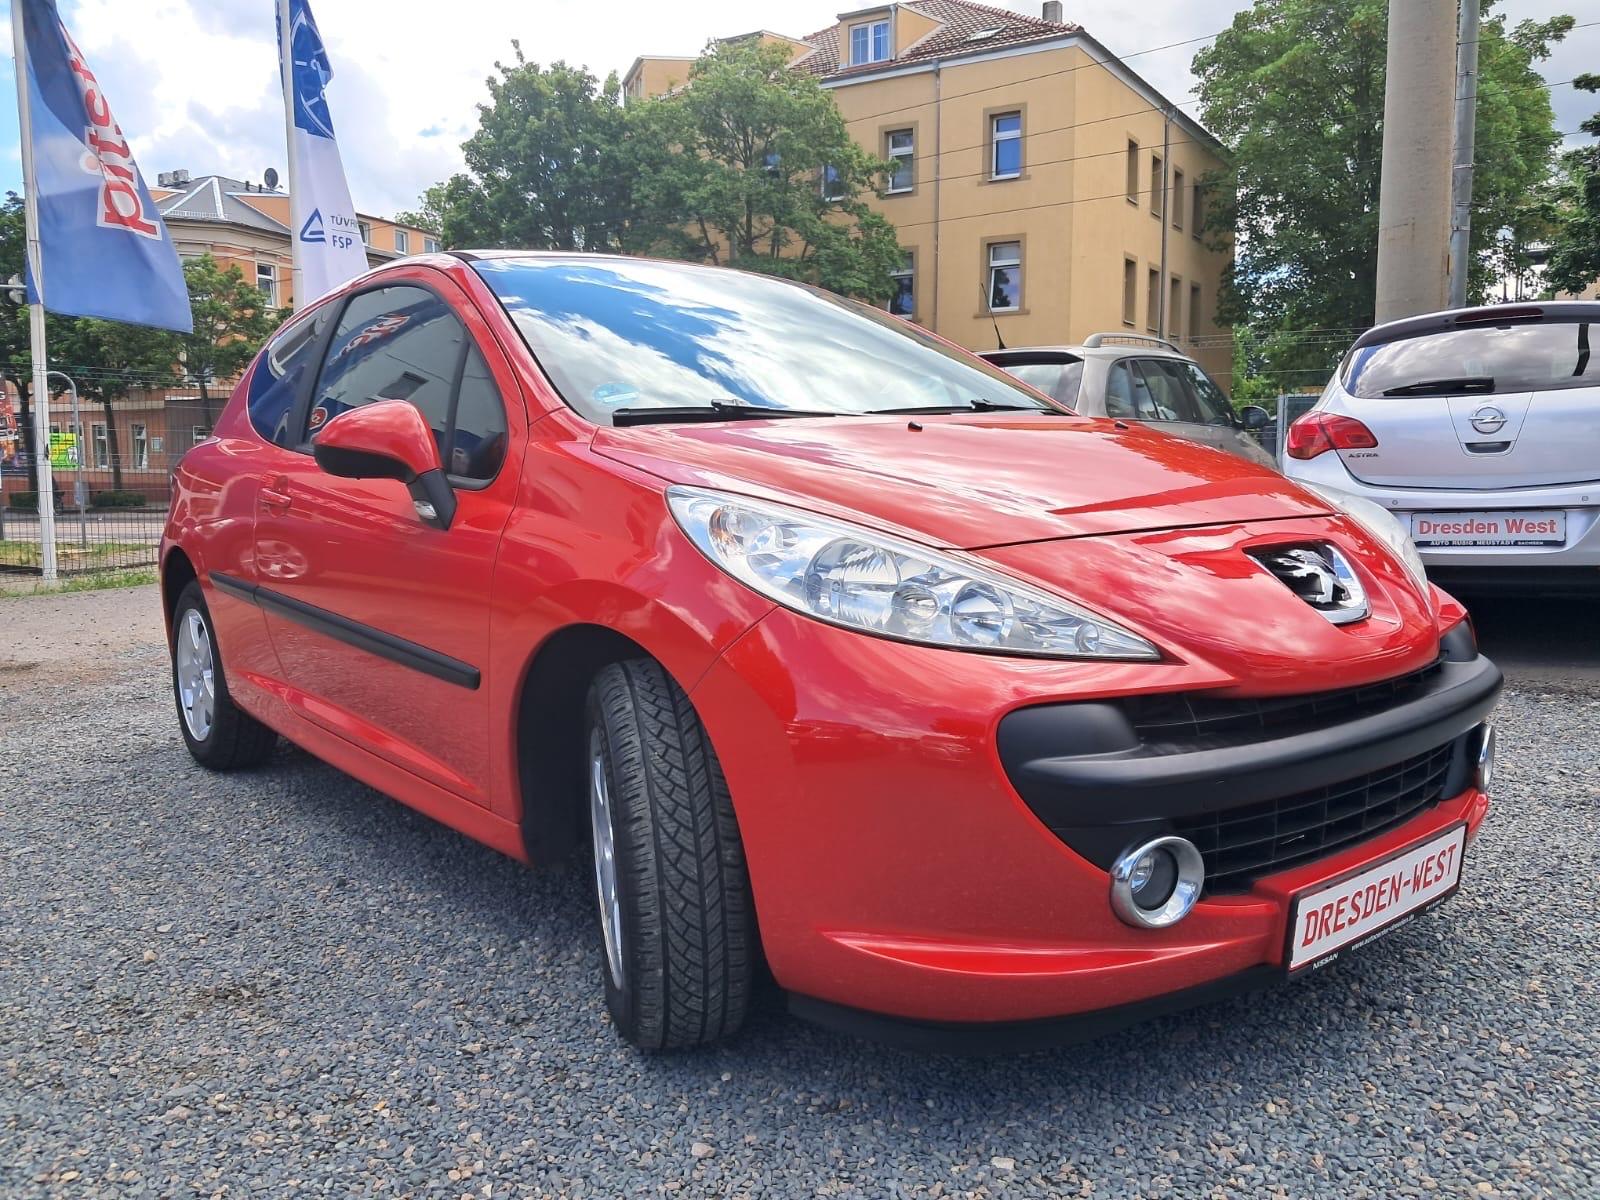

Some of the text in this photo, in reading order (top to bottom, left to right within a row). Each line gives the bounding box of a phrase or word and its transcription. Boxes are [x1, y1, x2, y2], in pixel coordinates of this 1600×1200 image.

[332, 235, 352, 249] FSP
[1419, 518, 1557, 535] Dresden West
[1302, 843, 1457, 948] DRESDEN-WEST
[1312, 952, 1339, 971] NISSAN
